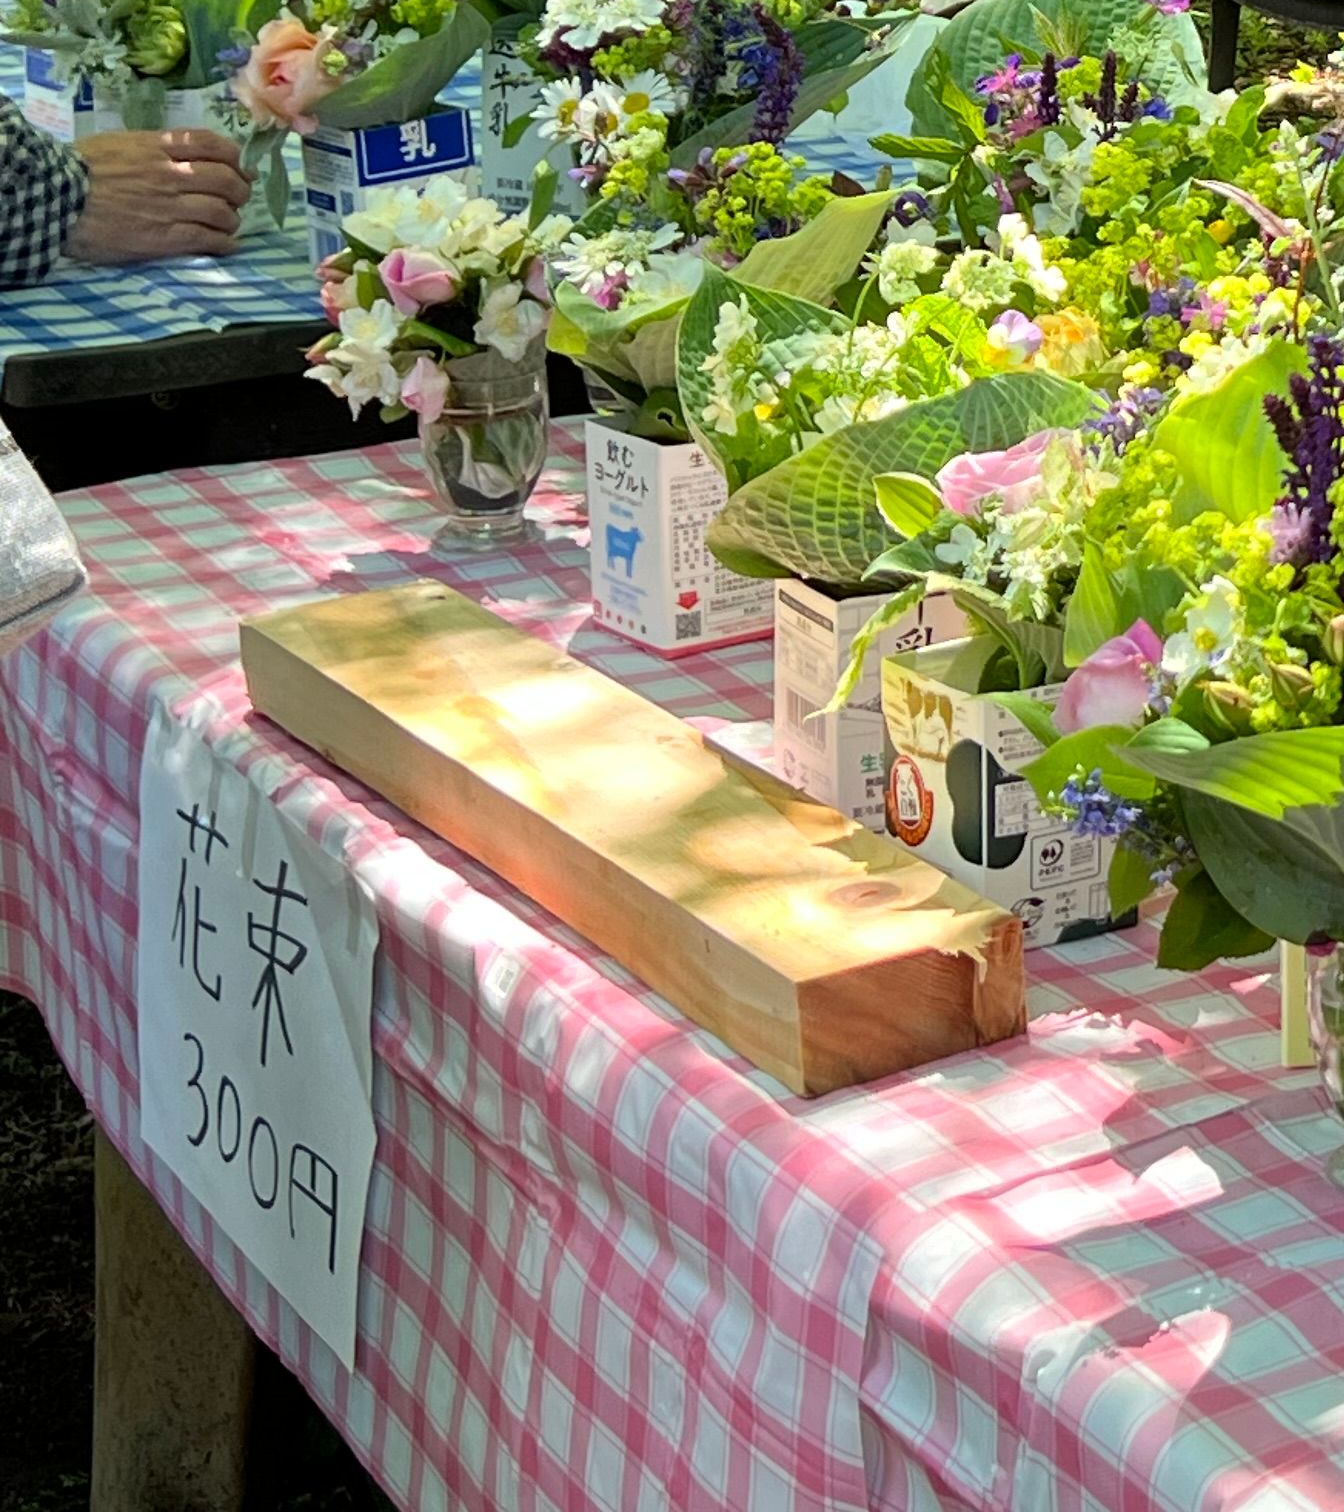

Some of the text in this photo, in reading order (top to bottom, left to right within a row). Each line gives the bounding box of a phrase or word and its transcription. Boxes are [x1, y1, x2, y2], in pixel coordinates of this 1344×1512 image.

[594, 461, 649, 499] ヨーグルト
[606, 439, 635, 469] 飲む
[171, 803, 309, 1067] 花束
[182, 1032, 339, 1276] 300円
